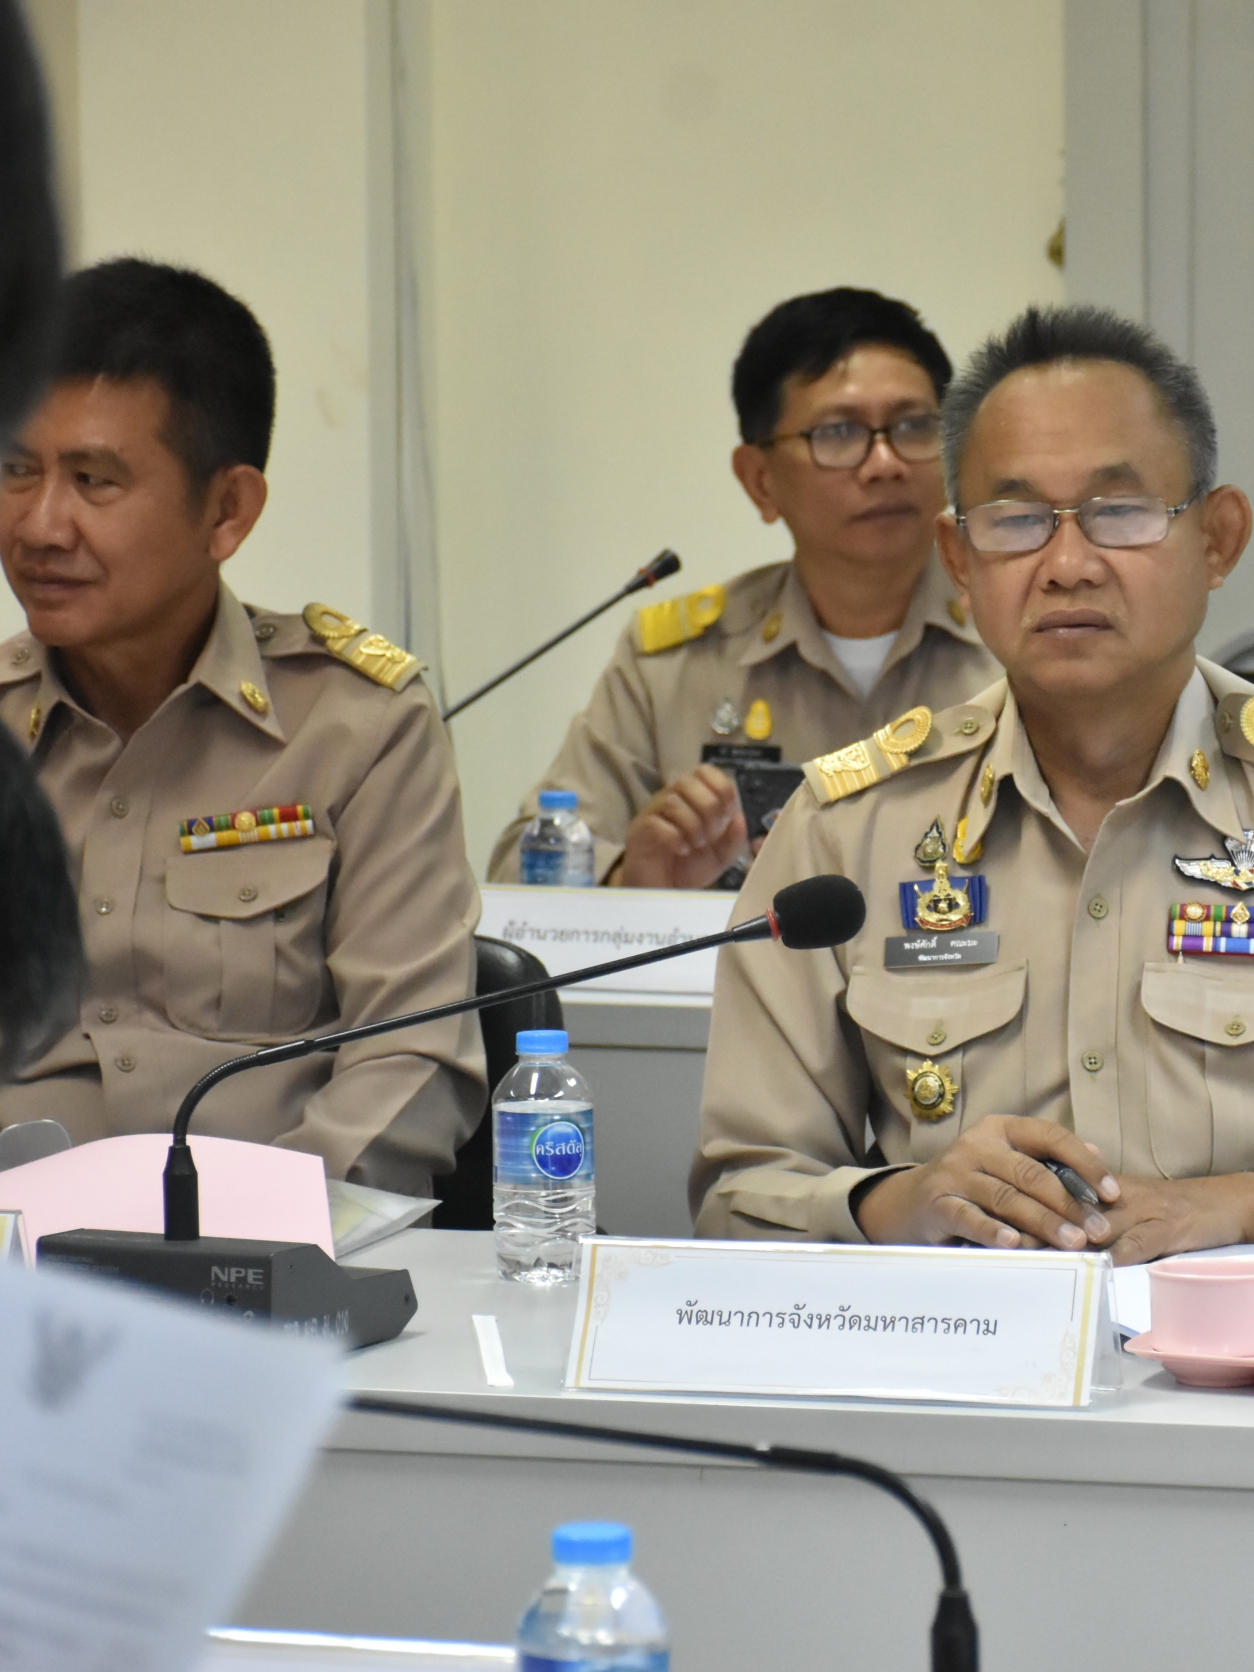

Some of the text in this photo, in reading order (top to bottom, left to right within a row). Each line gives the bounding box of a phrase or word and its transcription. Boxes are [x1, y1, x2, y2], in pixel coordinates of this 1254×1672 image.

[211, 1265, 264, 1285] NPE
[675, 1299, 998, 1337] พัฒนาการจังหวัดมหาสารคาม
